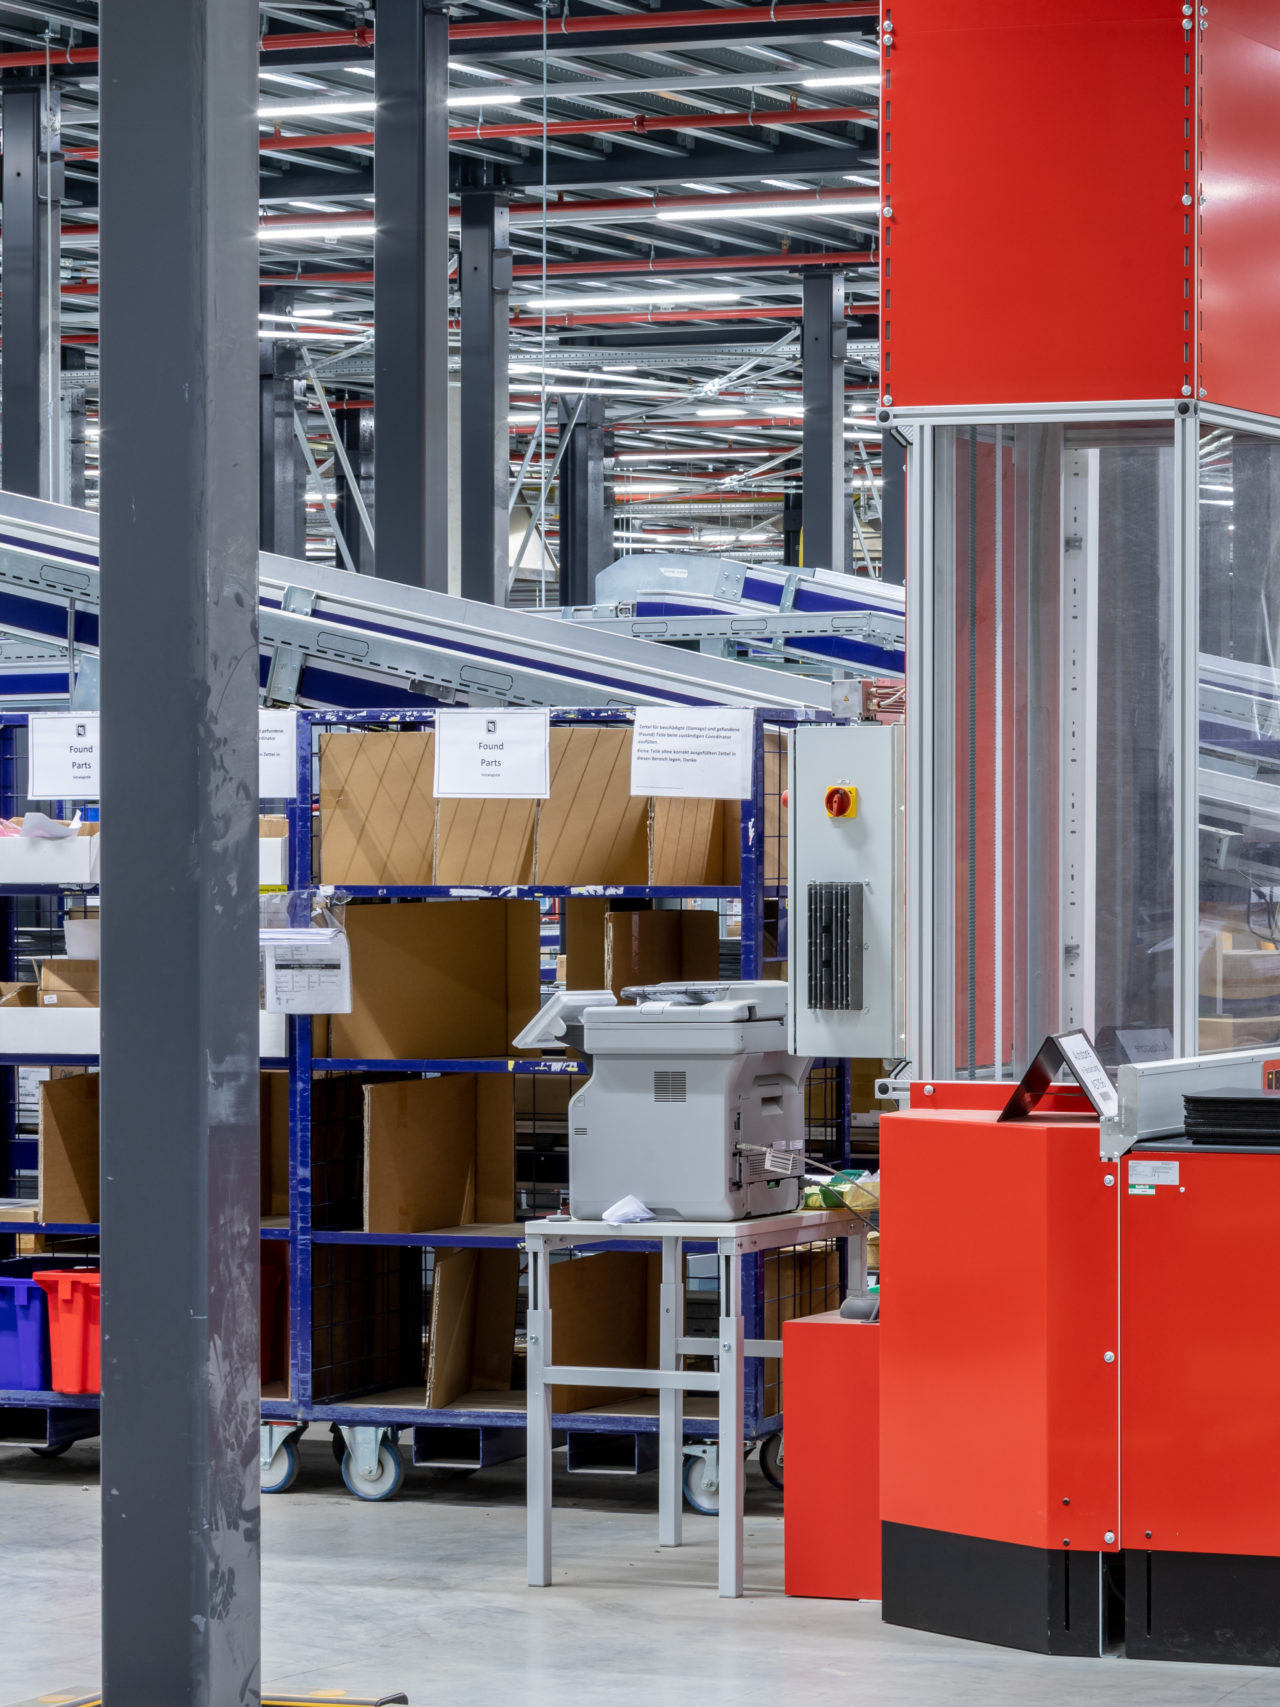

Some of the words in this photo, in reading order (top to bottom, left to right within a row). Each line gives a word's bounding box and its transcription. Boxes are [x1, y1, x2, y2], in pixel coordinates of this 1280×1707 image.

[69, 745, 93, 753] Found
[478, 742, 504, 751] Found
[71, 761, 92, 769] Parts
[480, 758, 502, 767] Parts
